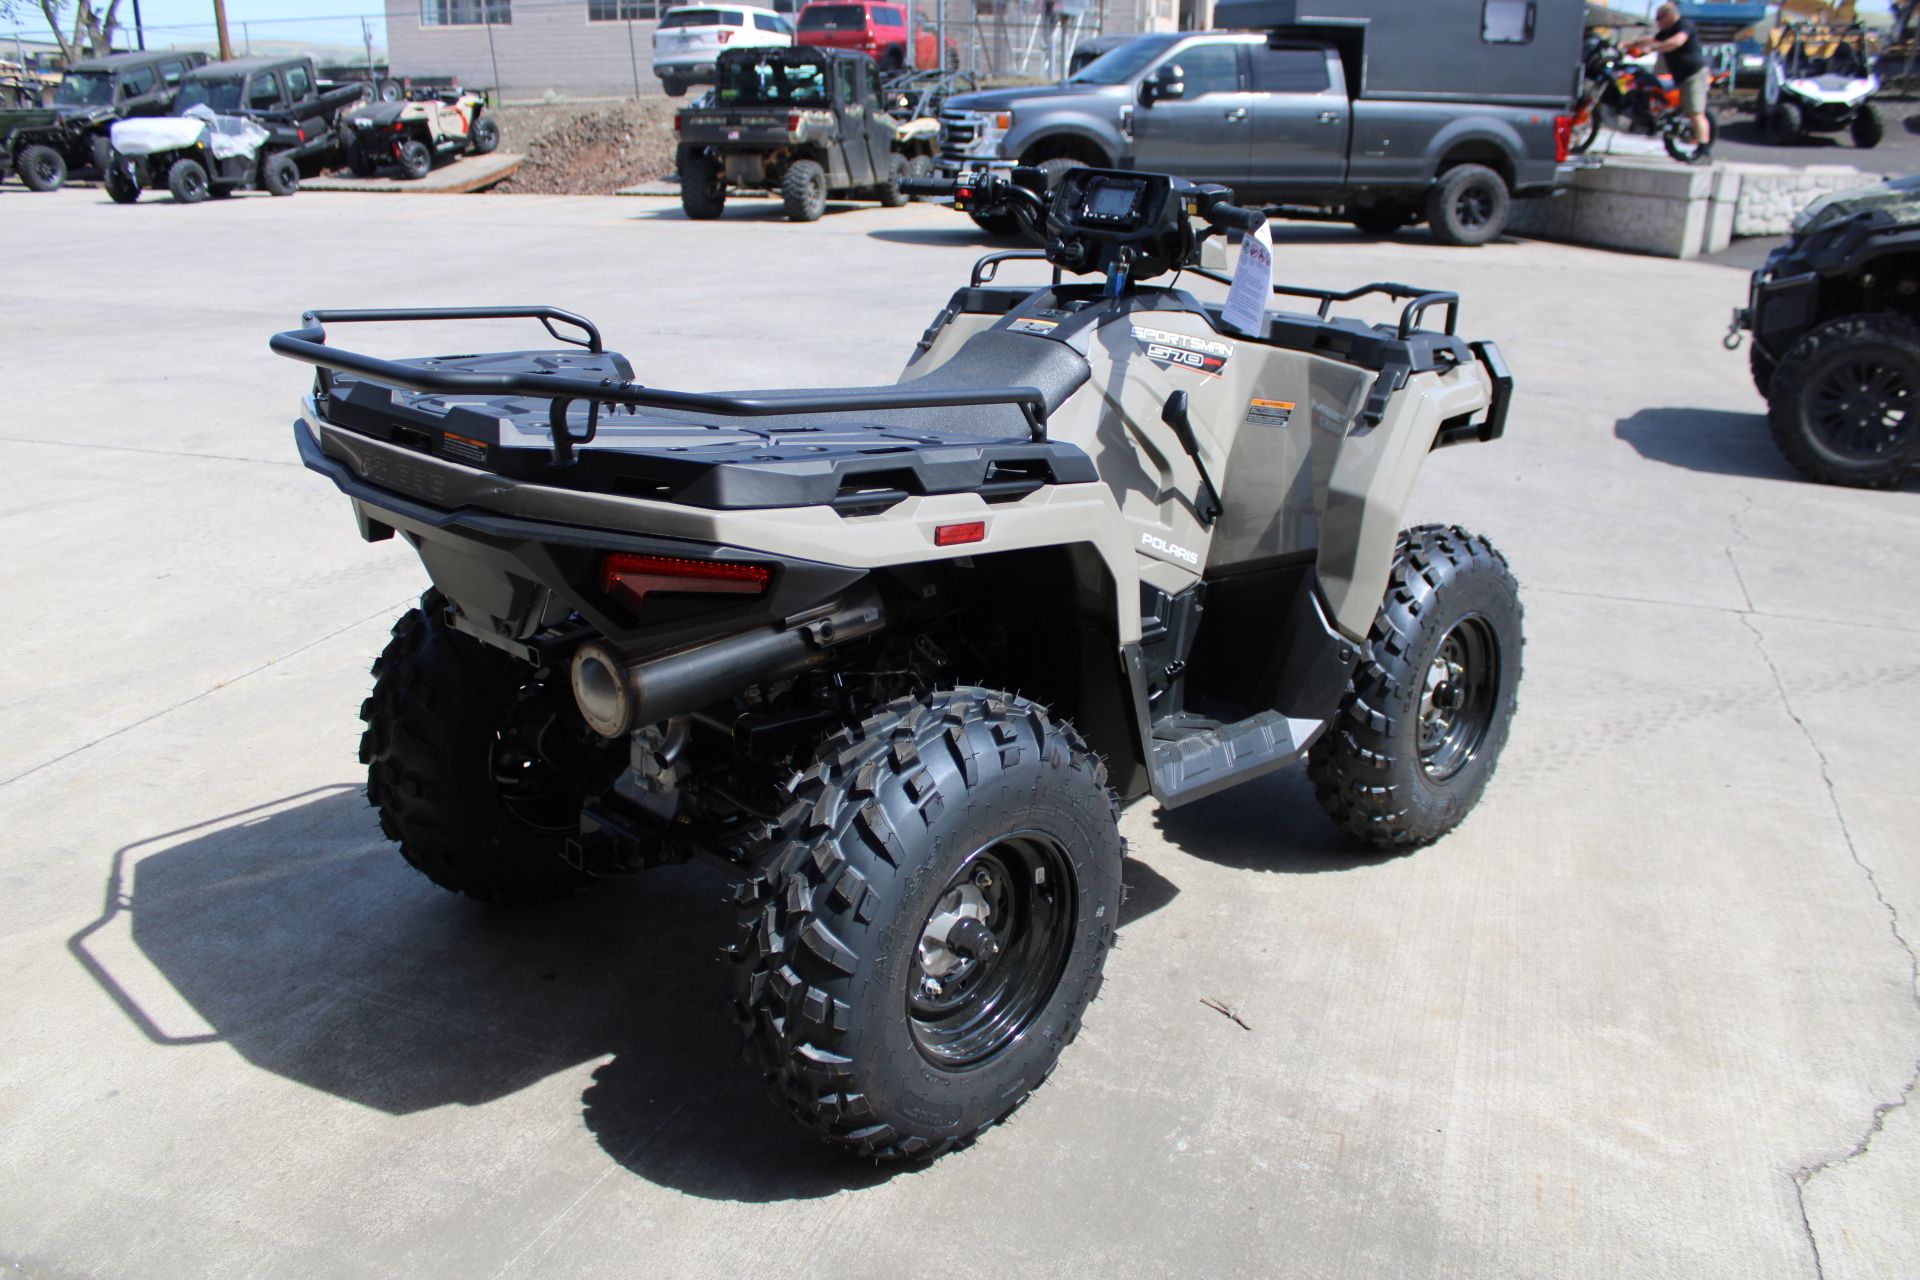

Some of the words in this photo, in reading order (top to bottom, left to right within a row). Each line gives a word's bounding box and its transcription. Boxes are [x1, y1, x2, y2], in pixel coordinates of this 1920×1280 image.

[1131, 326, 1234, 356] SPORTSMAN
[1147, 343, 1204, 367] 570
[1141, 532, 1199, 565] POLARIS
